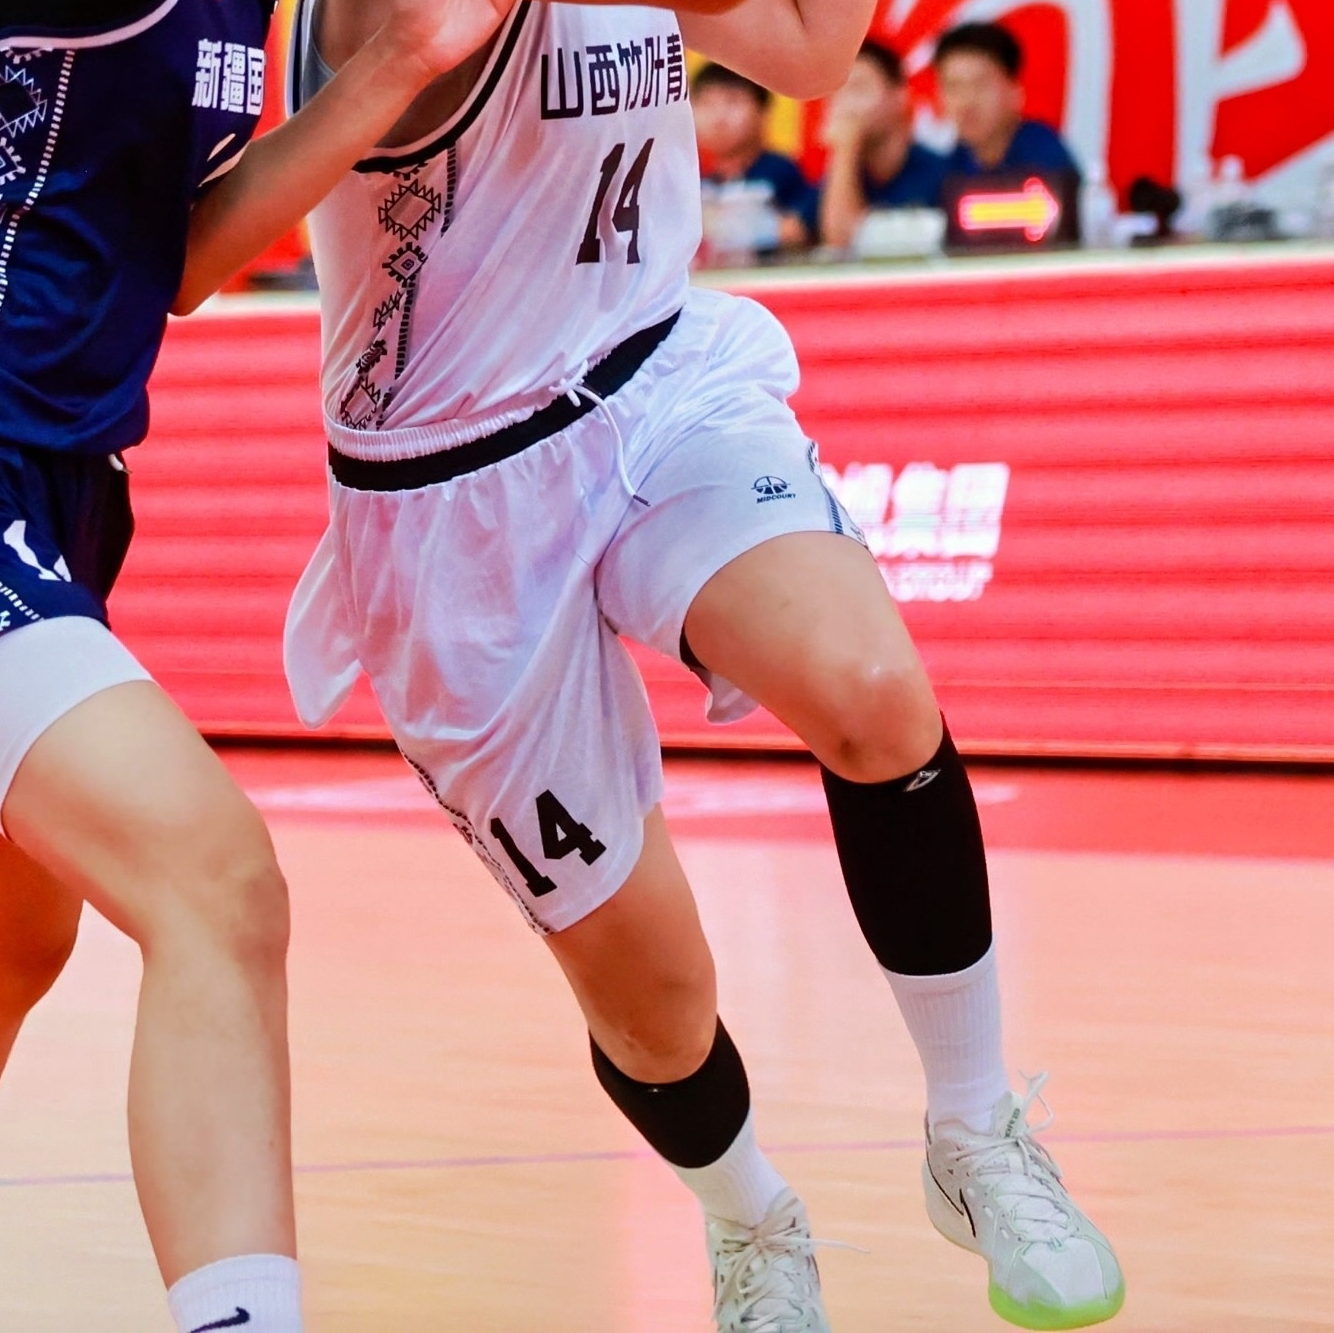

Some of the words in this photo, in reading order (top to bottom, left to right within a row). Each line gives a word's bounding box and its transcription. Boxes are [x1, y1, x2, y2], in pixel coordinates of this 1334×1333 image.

[540, 32, 689, 121] 山西竹叶青
[575, 137, 655, 266] 14
[490, 788, 607, 899] 14
